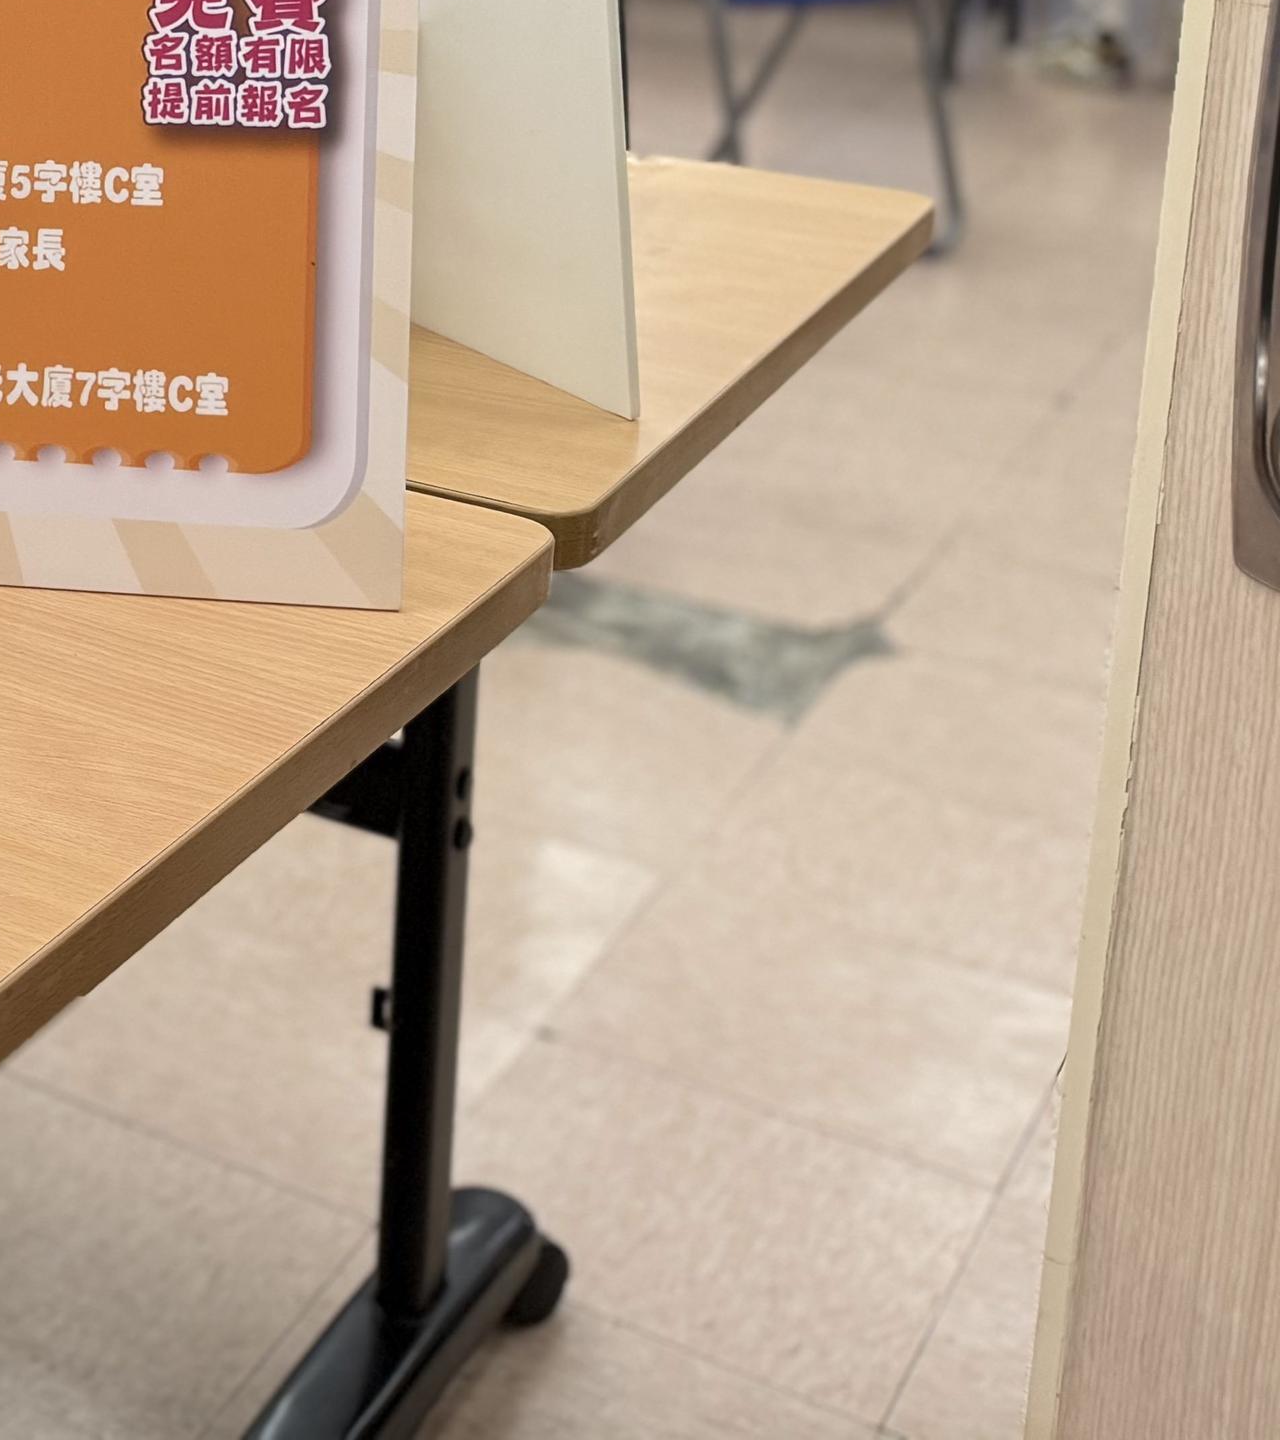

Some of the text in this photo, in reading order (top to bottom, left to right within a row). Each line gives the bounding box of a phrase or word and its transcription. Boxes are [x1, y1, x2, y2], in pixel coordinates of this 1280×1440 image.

[146, 31, 329, 77] 名額有限
[146, 79, 328, 126] 提前報名
